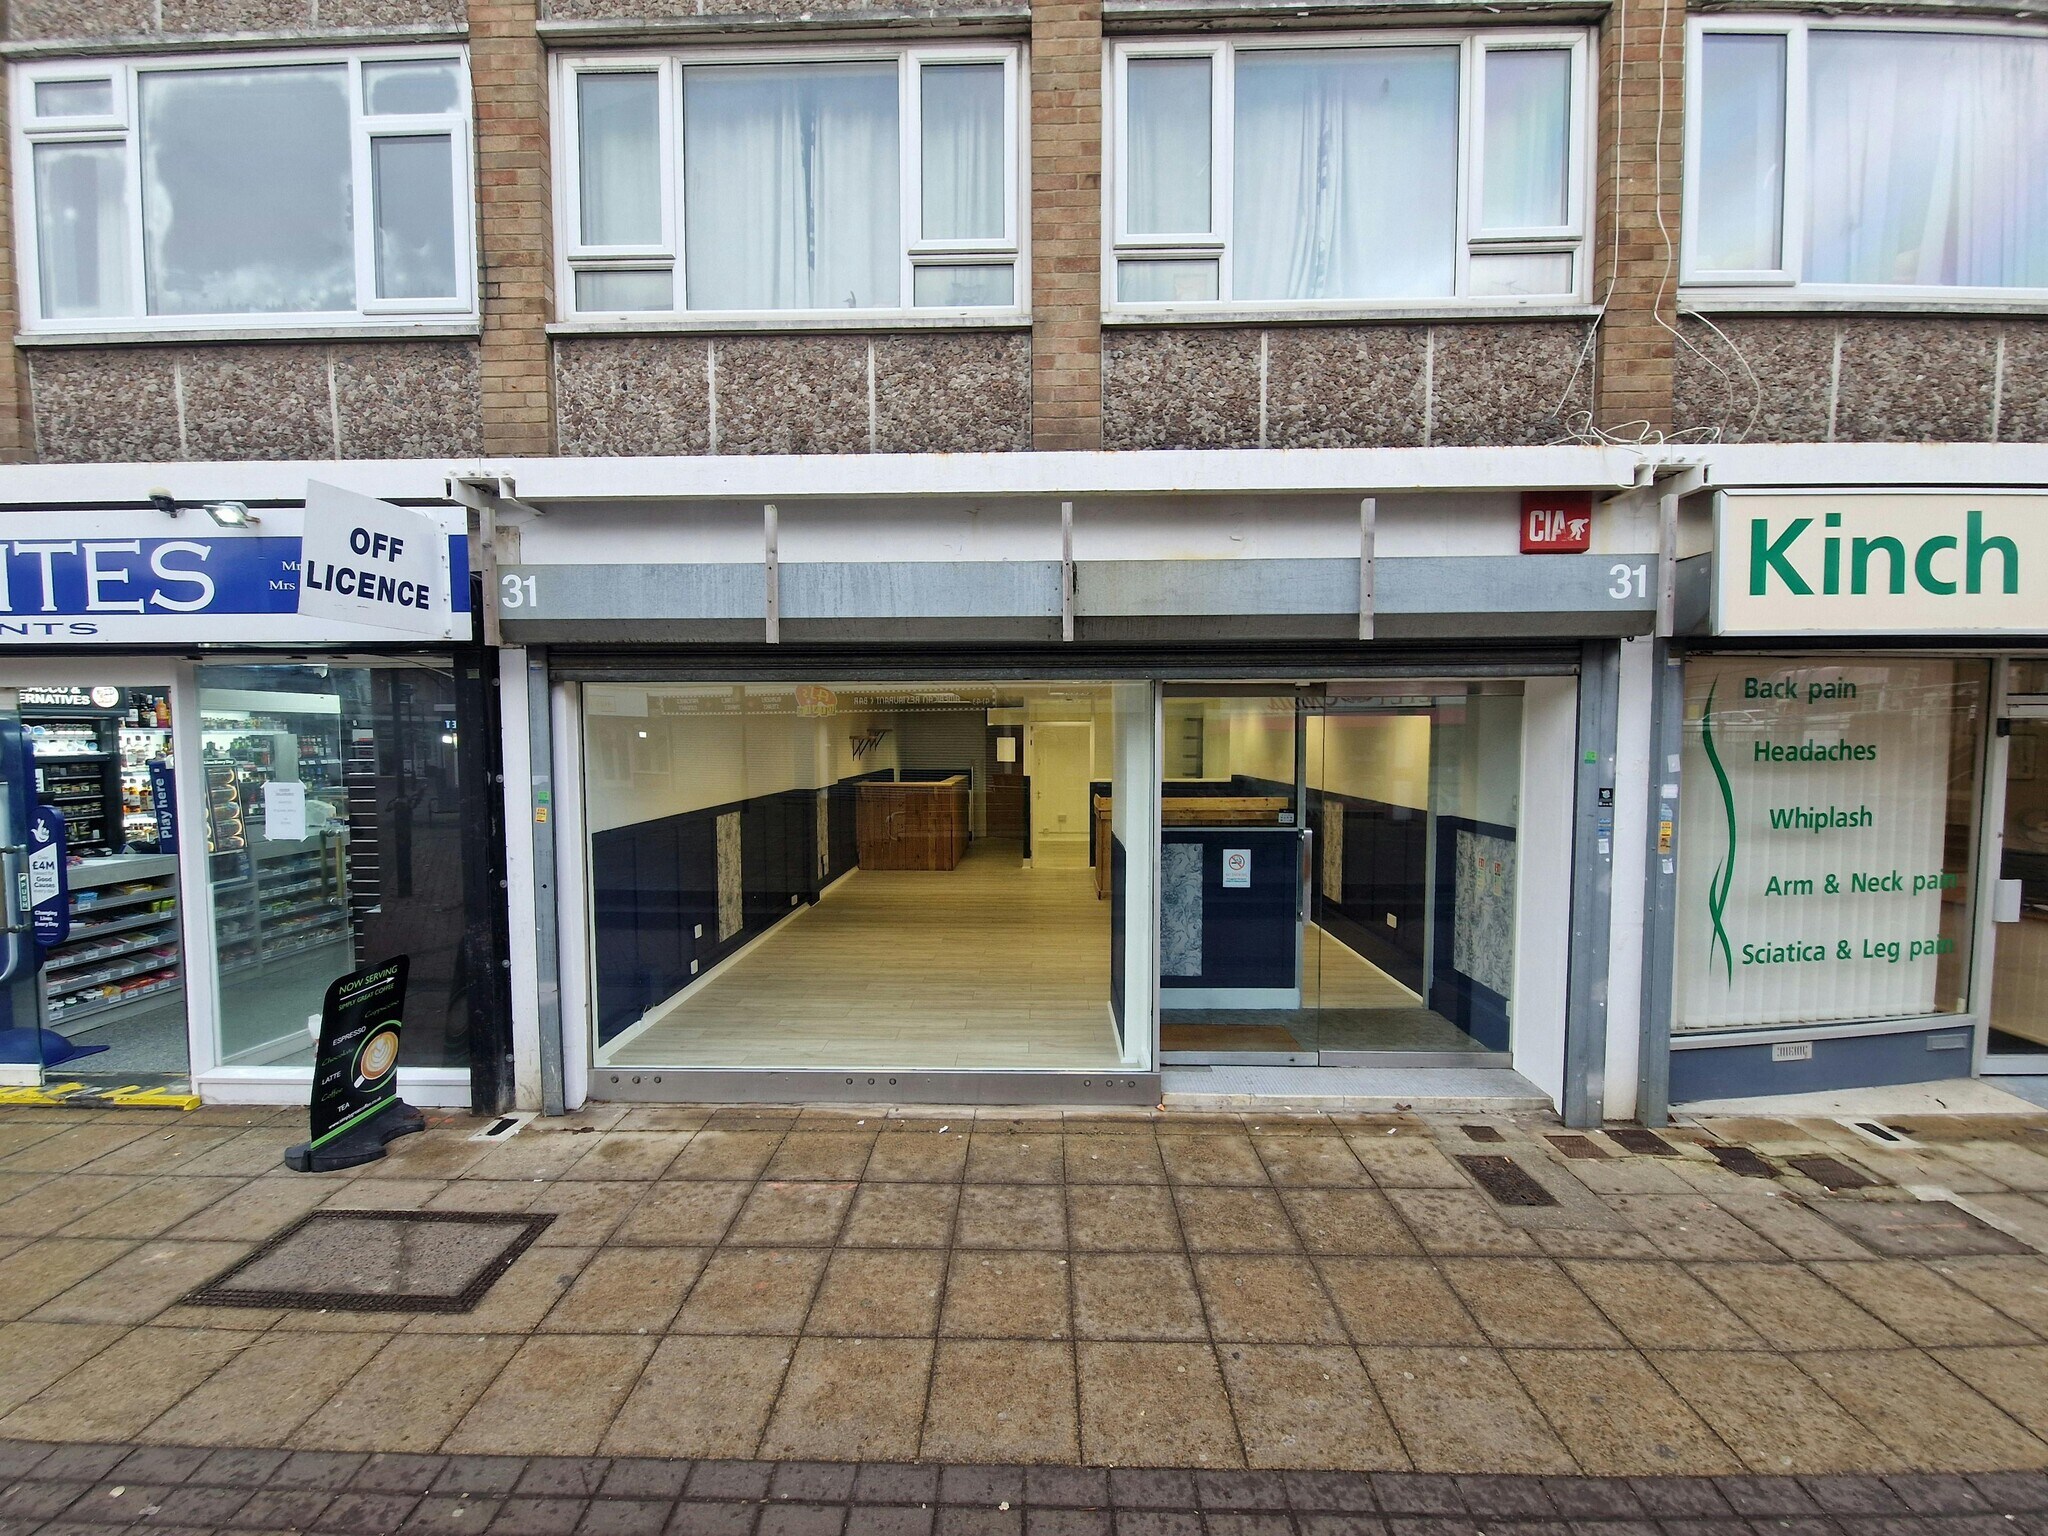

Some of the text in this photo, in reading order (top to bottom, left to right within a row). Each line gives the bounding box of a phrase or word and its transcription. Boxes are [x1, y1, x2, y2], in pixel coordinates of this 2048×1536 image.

[1529, 509, 1567, 542] CIA
[350, 527, 404, 562] OFF
[1749, 510, 2018, 595] Kinch
[269, 580, 296, 591] Mrs
[307, 560, 430, 610] LICENCE
[502, 574, 537, 608] 31
[1609, 563, 1647, 599] 31
[1743, 676, 1857, 704] Back pain
[1754, 739, 1877, 763] Headaches
[156, 778, 173, 839] Play here
[1769, 805, 1873, 833] Whiplash
[32, 861, 55, 870] £4M
[1764, 869, 1957, 897] Arm & Neck pain
[1742, 934, 1954, 964] Sciatica & Leg pain
[339, 964, 398, 995] NOW SERVING
[338, 982, 395, 1012] SIMPLY GREAT COFFEE
[332, 1025, 367, 1046] ESPRESSO
[322, 1070, 342, 1085] LATTE
[337, 1102, 350, 1113] TEA
